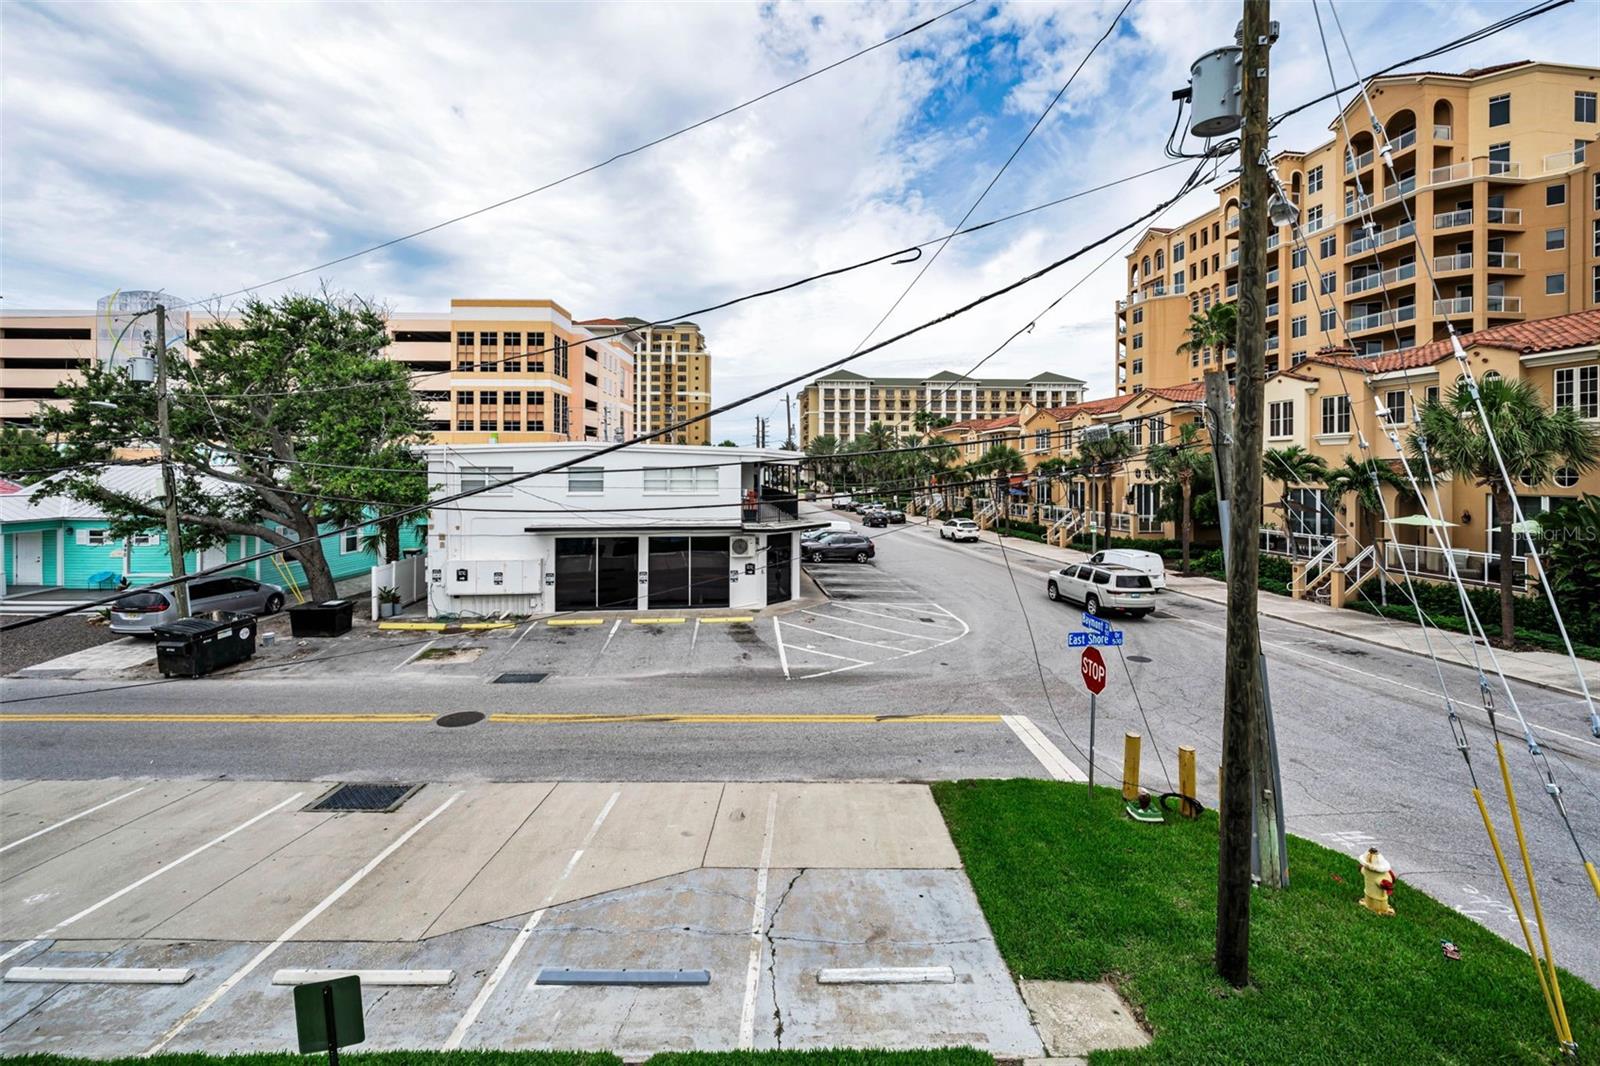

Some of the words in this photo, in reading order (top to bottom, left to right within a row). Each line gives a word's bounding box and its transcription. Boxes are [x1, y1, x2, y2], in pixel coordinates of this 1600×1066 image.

[1069, 634, 1086, 645] East
[1088, 633, 1109, 645] Shore
[1082, 656, 1105, 682] STOP
